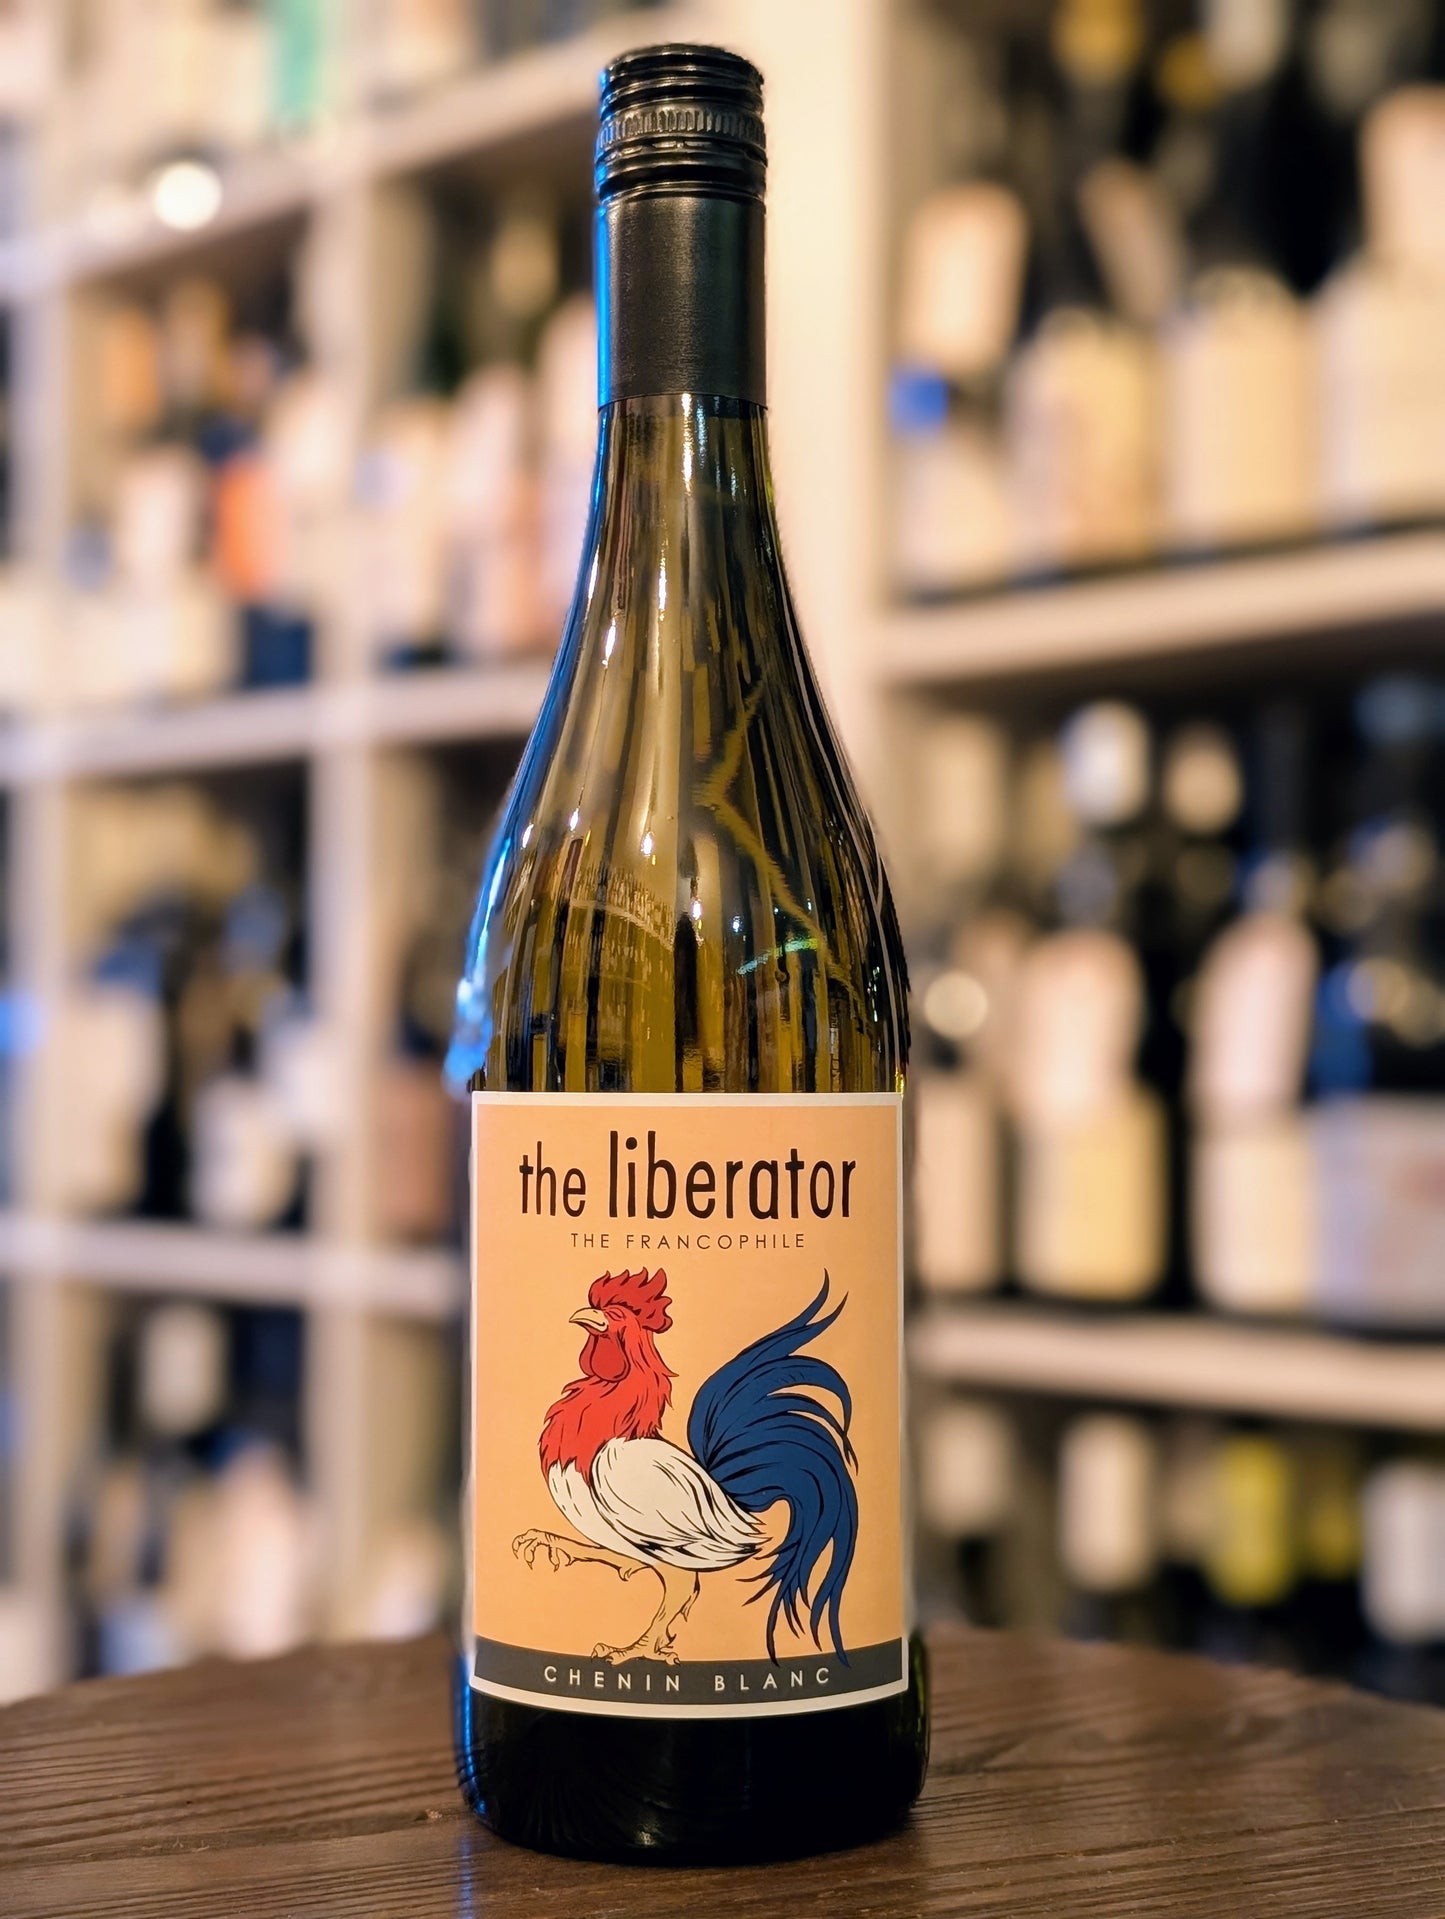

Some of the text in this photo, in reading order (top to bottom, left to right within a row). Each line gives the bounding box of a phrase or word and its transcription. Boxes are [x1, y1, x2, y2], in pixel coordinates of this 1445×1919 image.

[519, 1130, 856, 1219] the liberator
[571, 1233, 805, 1249] THE FRANCOPHILE
[543, 1665, 830, 1691] CHENIN BLANC
